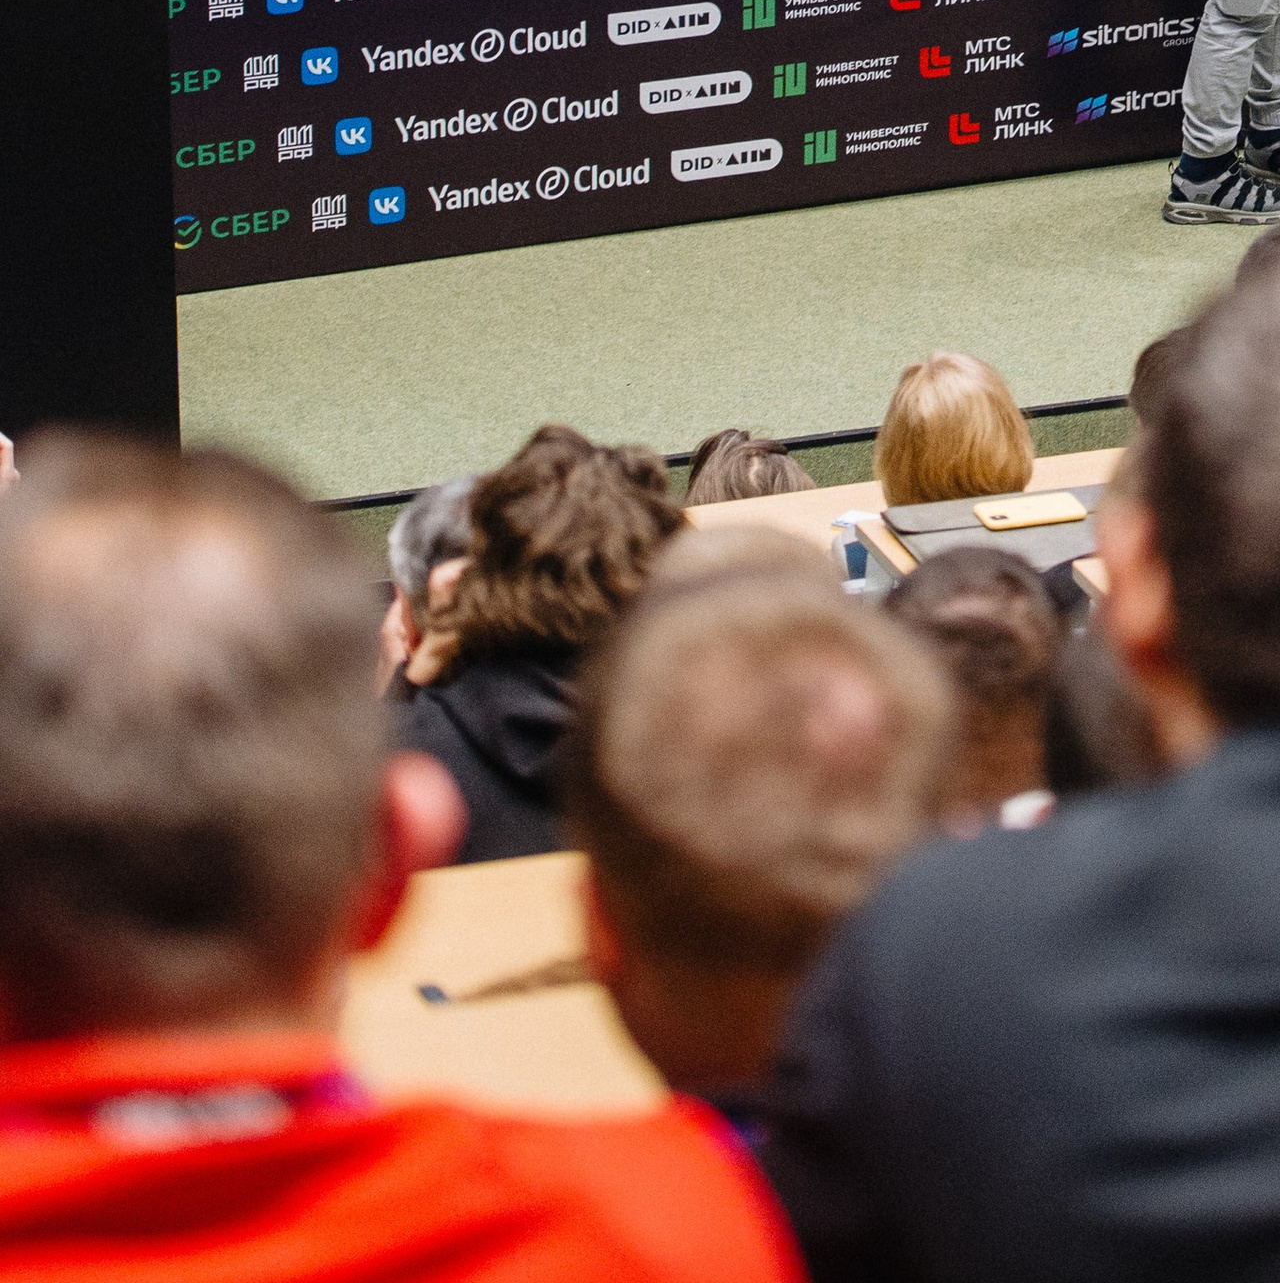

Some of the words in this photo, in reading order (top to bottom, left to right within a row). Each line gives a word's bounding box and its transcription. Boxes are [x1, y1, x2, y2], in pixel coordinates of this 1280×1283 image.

[785, 1, 862, 20] ИННОПОЛИС
[427, 177, 531, 212] Yandex
[573, 157, 650, 192] Cloud
[210, 208, 290, 238] СБЕР
